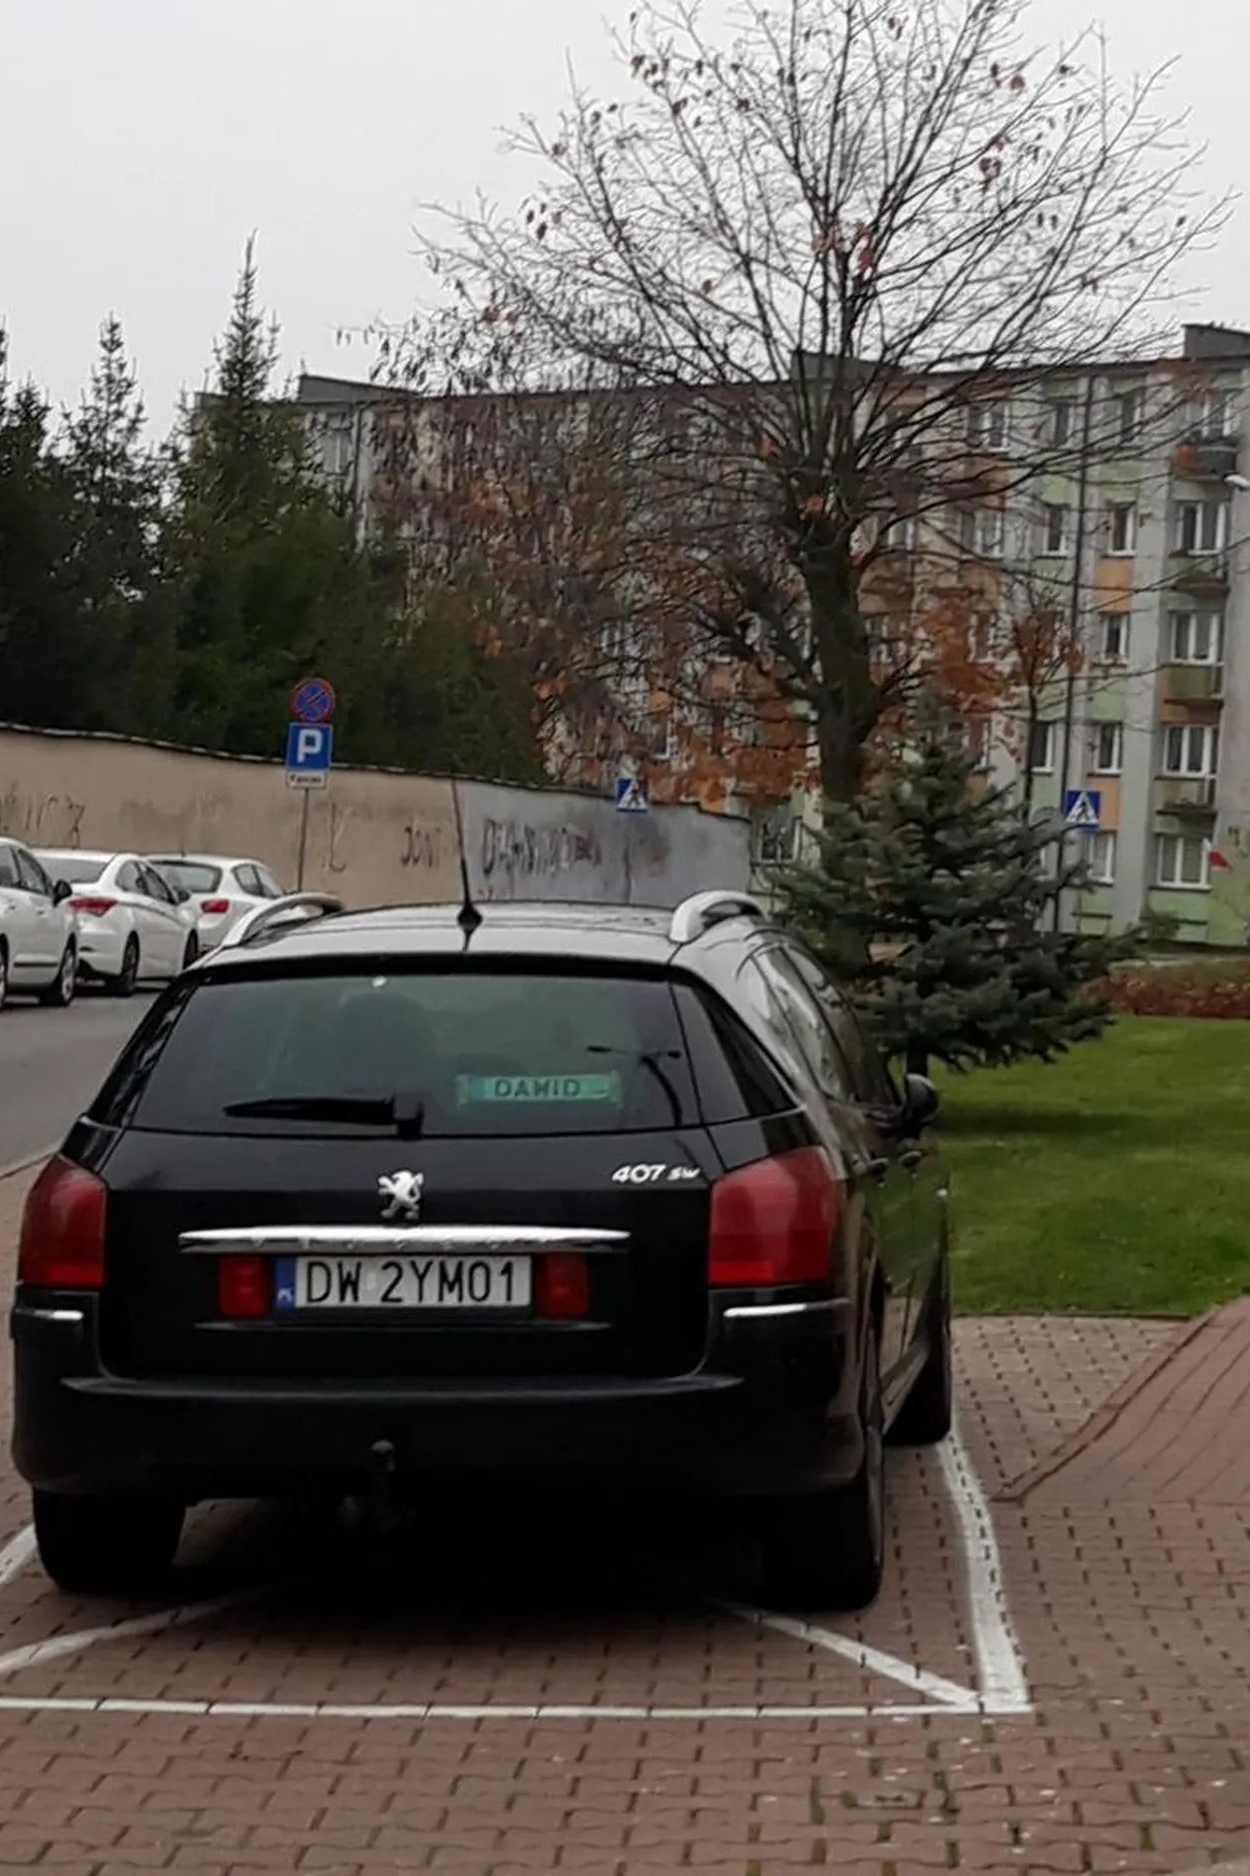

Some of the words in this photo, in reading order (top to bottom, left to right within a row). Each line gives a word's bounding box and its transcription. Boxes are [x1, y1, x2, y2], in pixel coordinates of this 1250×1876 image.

[297, 728, 323, 764] P
[611, 1164, 666, 1184] 407
[306, 1259, 363, 1304] DW
[379, 1259, 515, 1304] 2YM01
